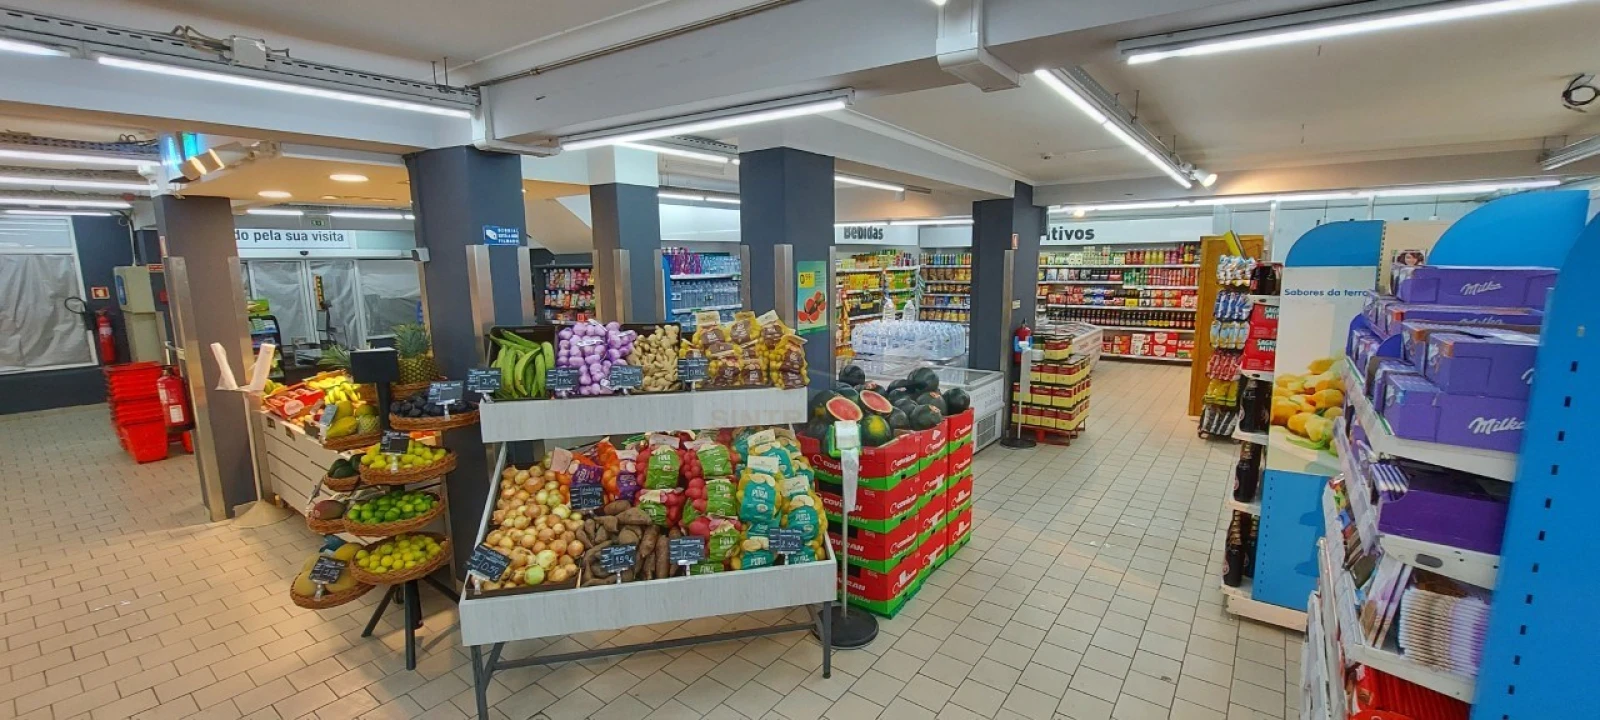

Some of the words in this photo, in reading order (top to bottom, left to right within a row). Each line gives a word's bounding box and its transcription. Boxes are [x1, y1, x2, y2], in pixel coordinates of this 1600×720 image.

[254, 230, 281, 243] pela
[285, 232, 308, 241] sua
[311, 230, 344, 242] visita
[1284, 289, 1324, 297] Sabores
[1327, 289, 1341, 297] da
[1344, 289, 1369, 297] terra
[1460, 281, 1503, 296] Milka
[1468, 417, 1527, 435] Milka
